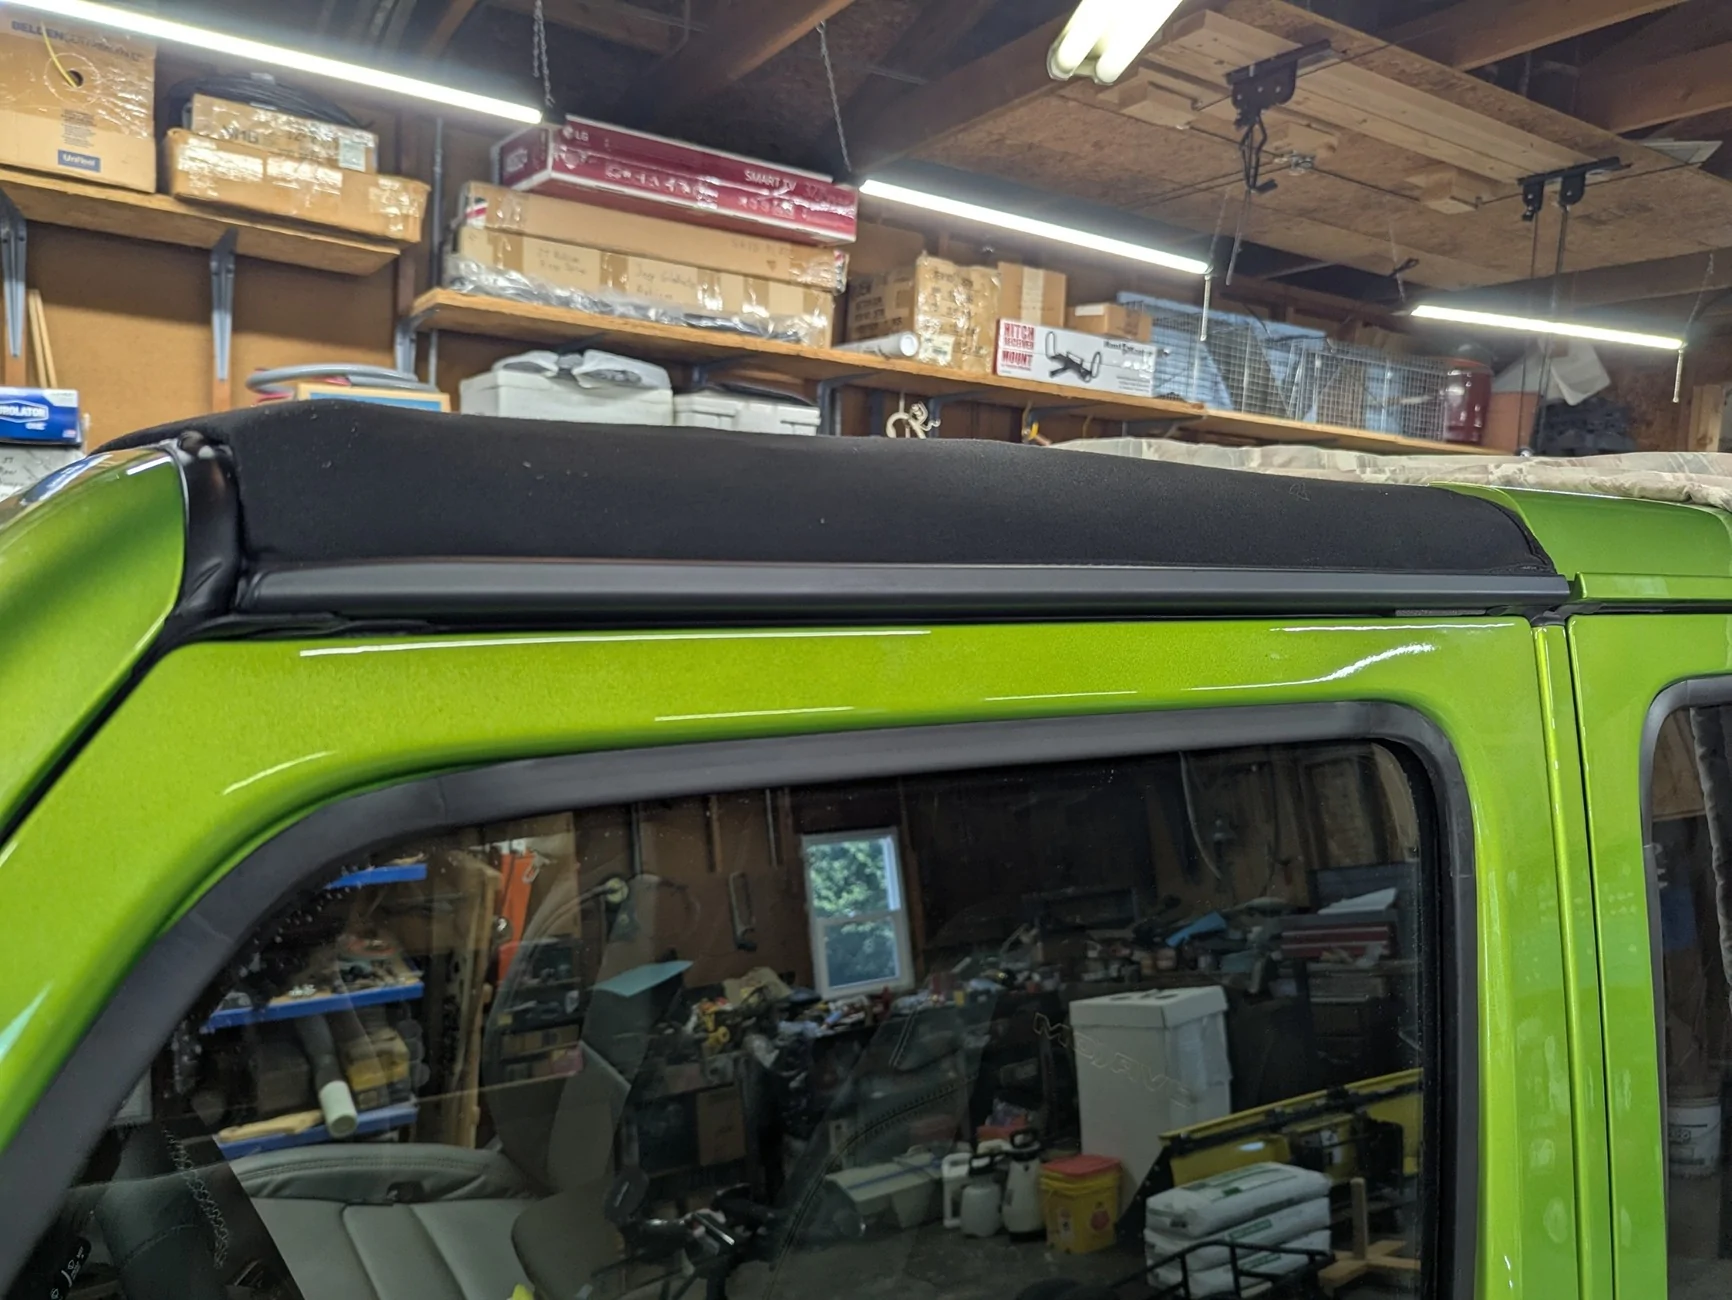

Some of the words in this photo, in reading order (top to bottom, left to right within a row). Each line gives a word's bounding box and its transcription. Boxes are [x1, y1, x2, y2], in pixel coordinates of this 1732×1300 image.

[575, 130, 590, 142] LG
[744, 169, 781, 187] SMART
[1004, 322, 1035, 342] HITCH
[1002, 350, 1033, 367] MOUNT
